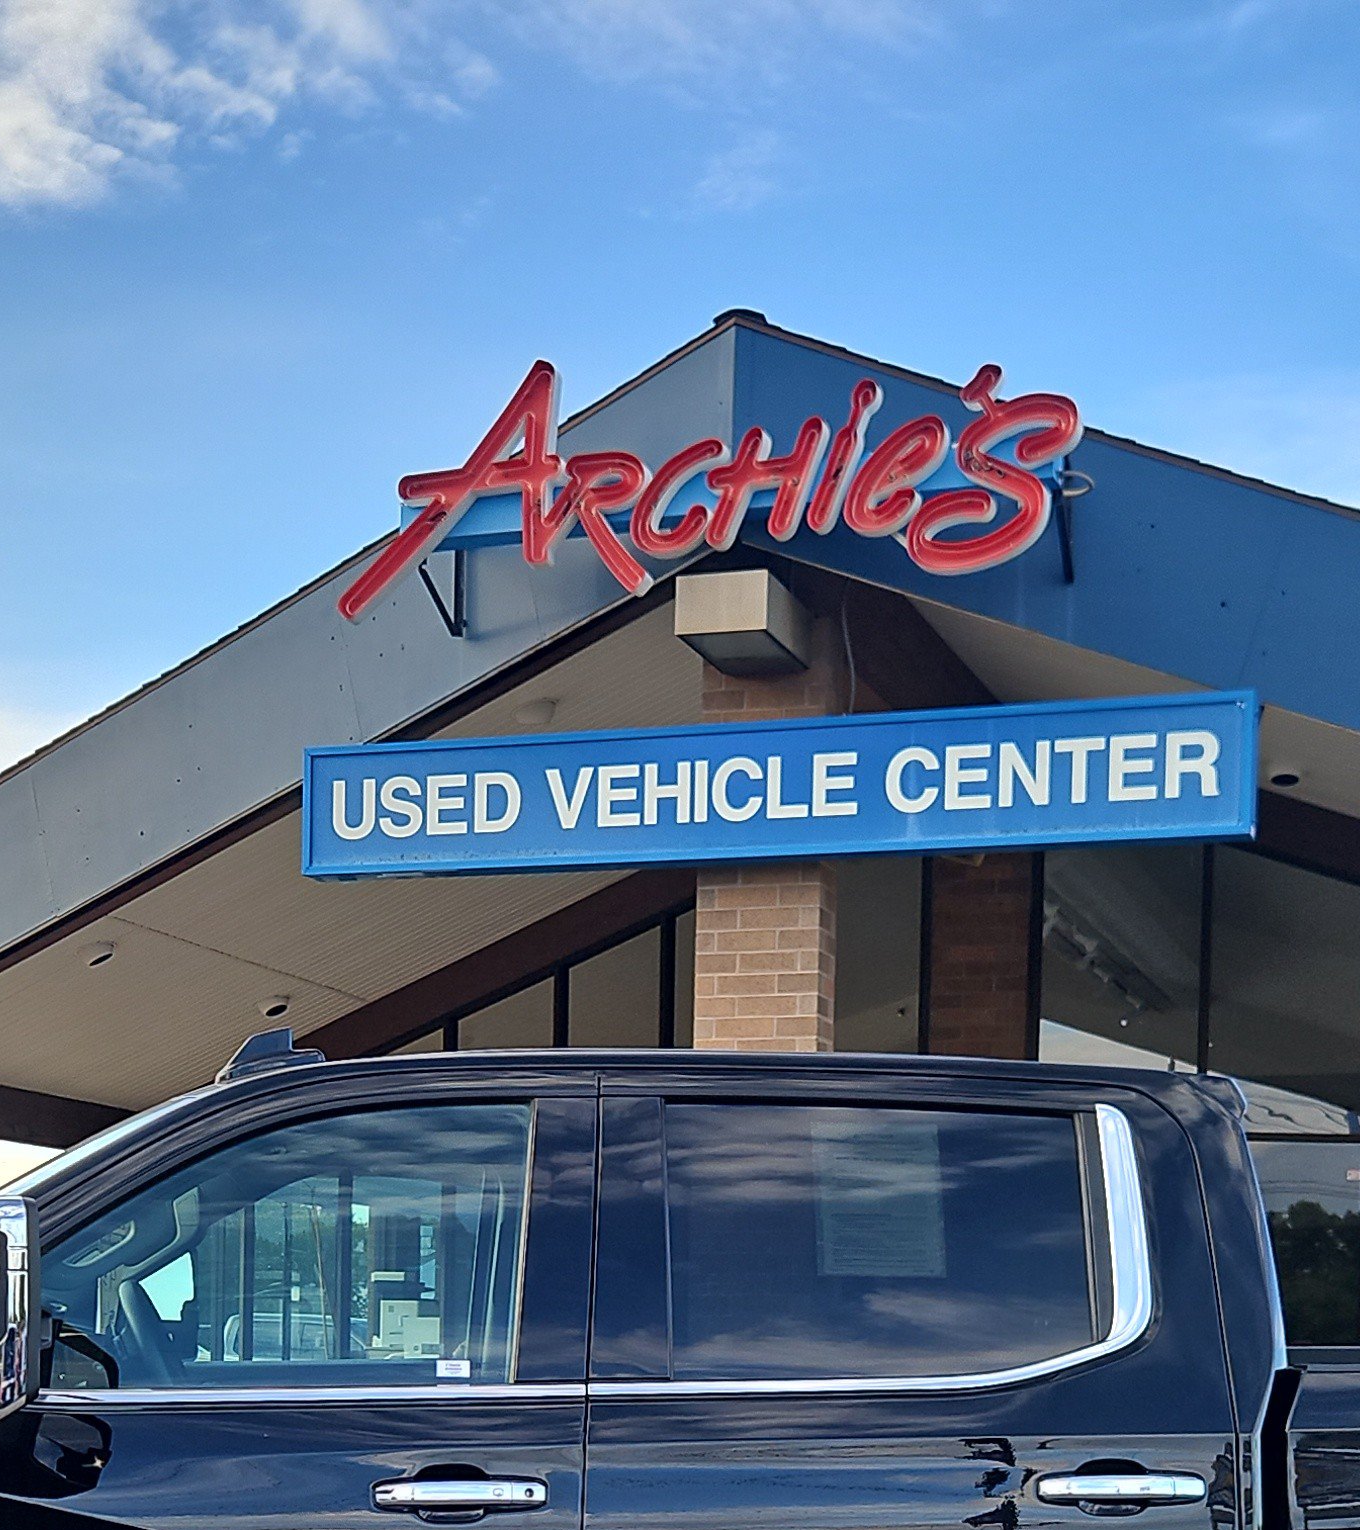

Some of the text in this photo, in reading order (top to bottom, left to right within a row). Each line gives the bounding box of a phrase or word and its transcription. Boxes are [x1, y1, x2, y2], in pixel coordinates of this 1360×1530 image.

[331, 729, 1222, 841] USED VEHICLE CENTER
